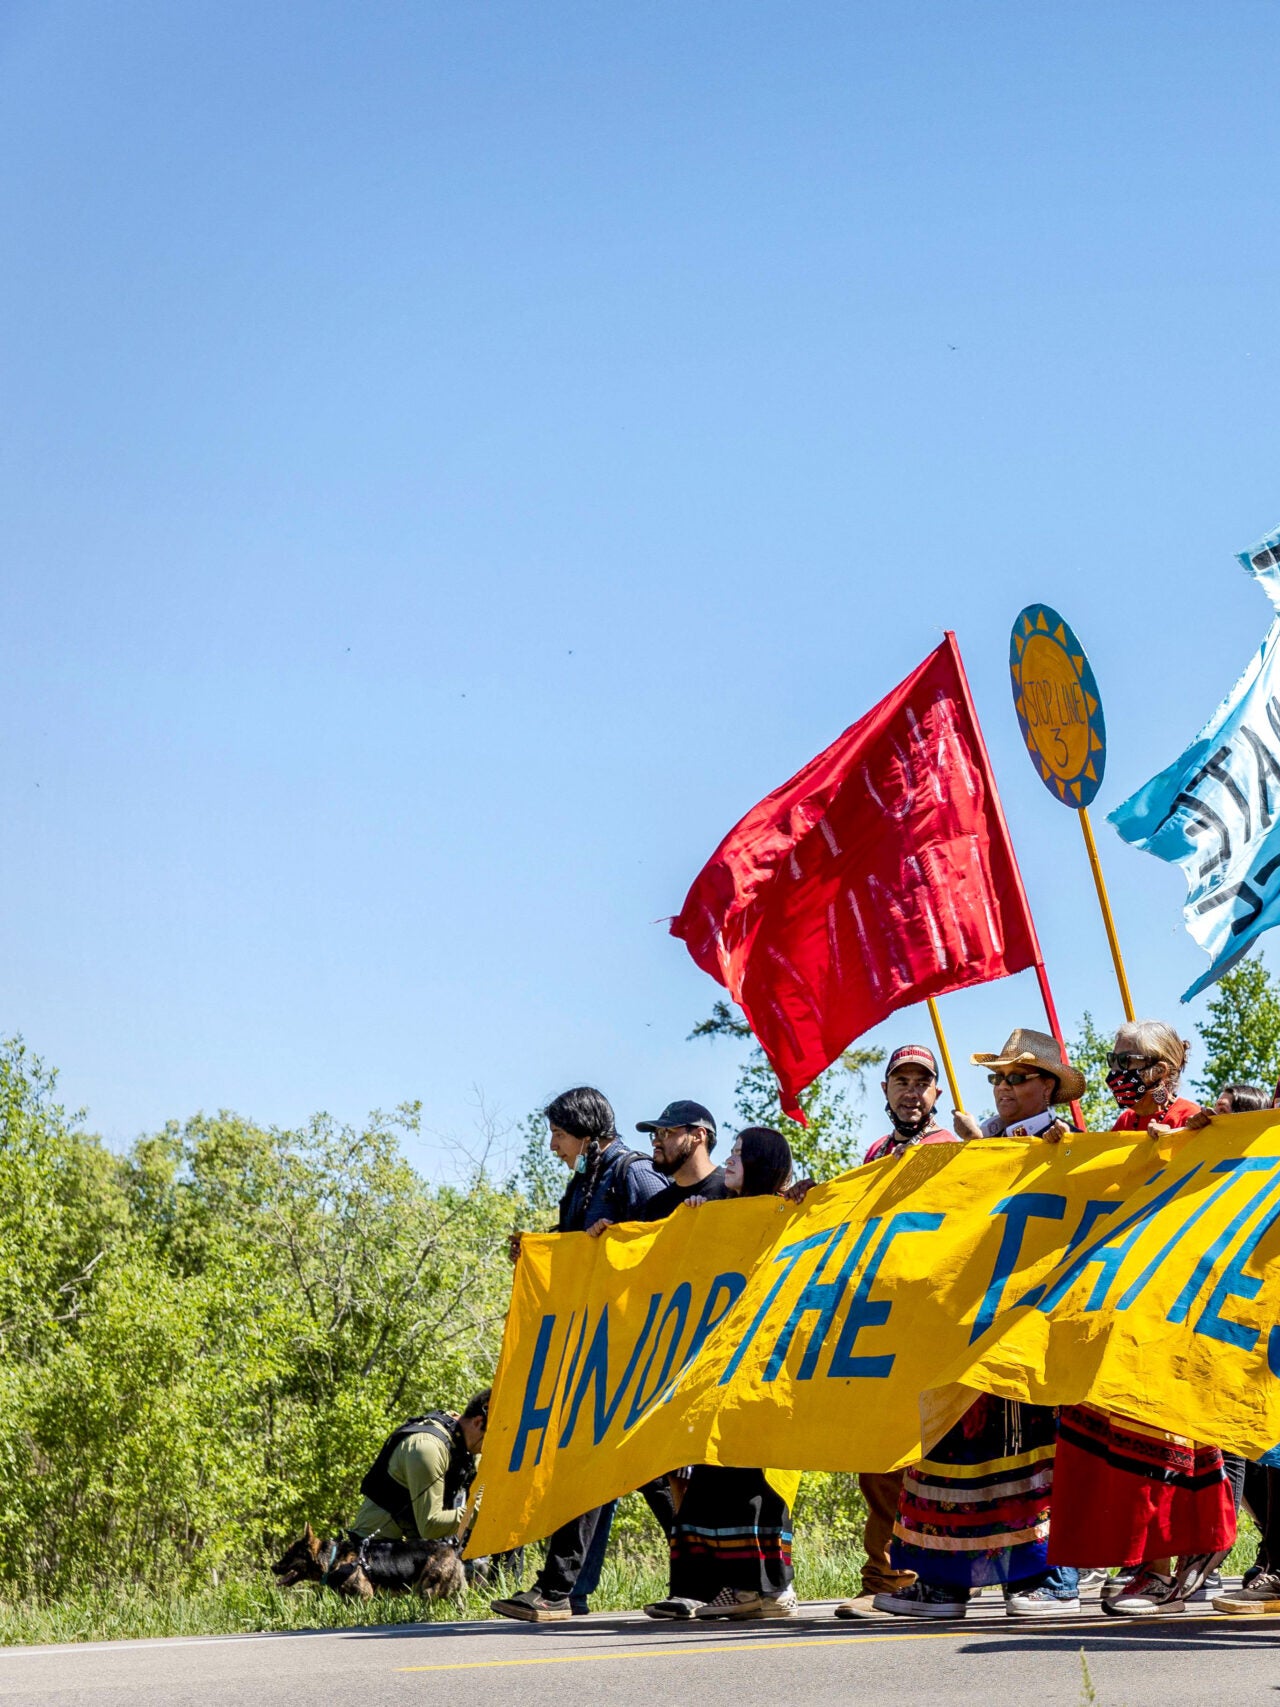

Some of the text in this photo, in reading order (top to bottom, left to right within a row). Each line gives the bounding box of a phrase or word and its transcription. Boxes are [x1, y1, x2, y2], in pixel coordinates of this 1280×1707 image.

[1023, 679, 1085, 727] STOP LINE
[1050, 728, 1068, 768] 3
[717, 1211, 948, 1388] THE
